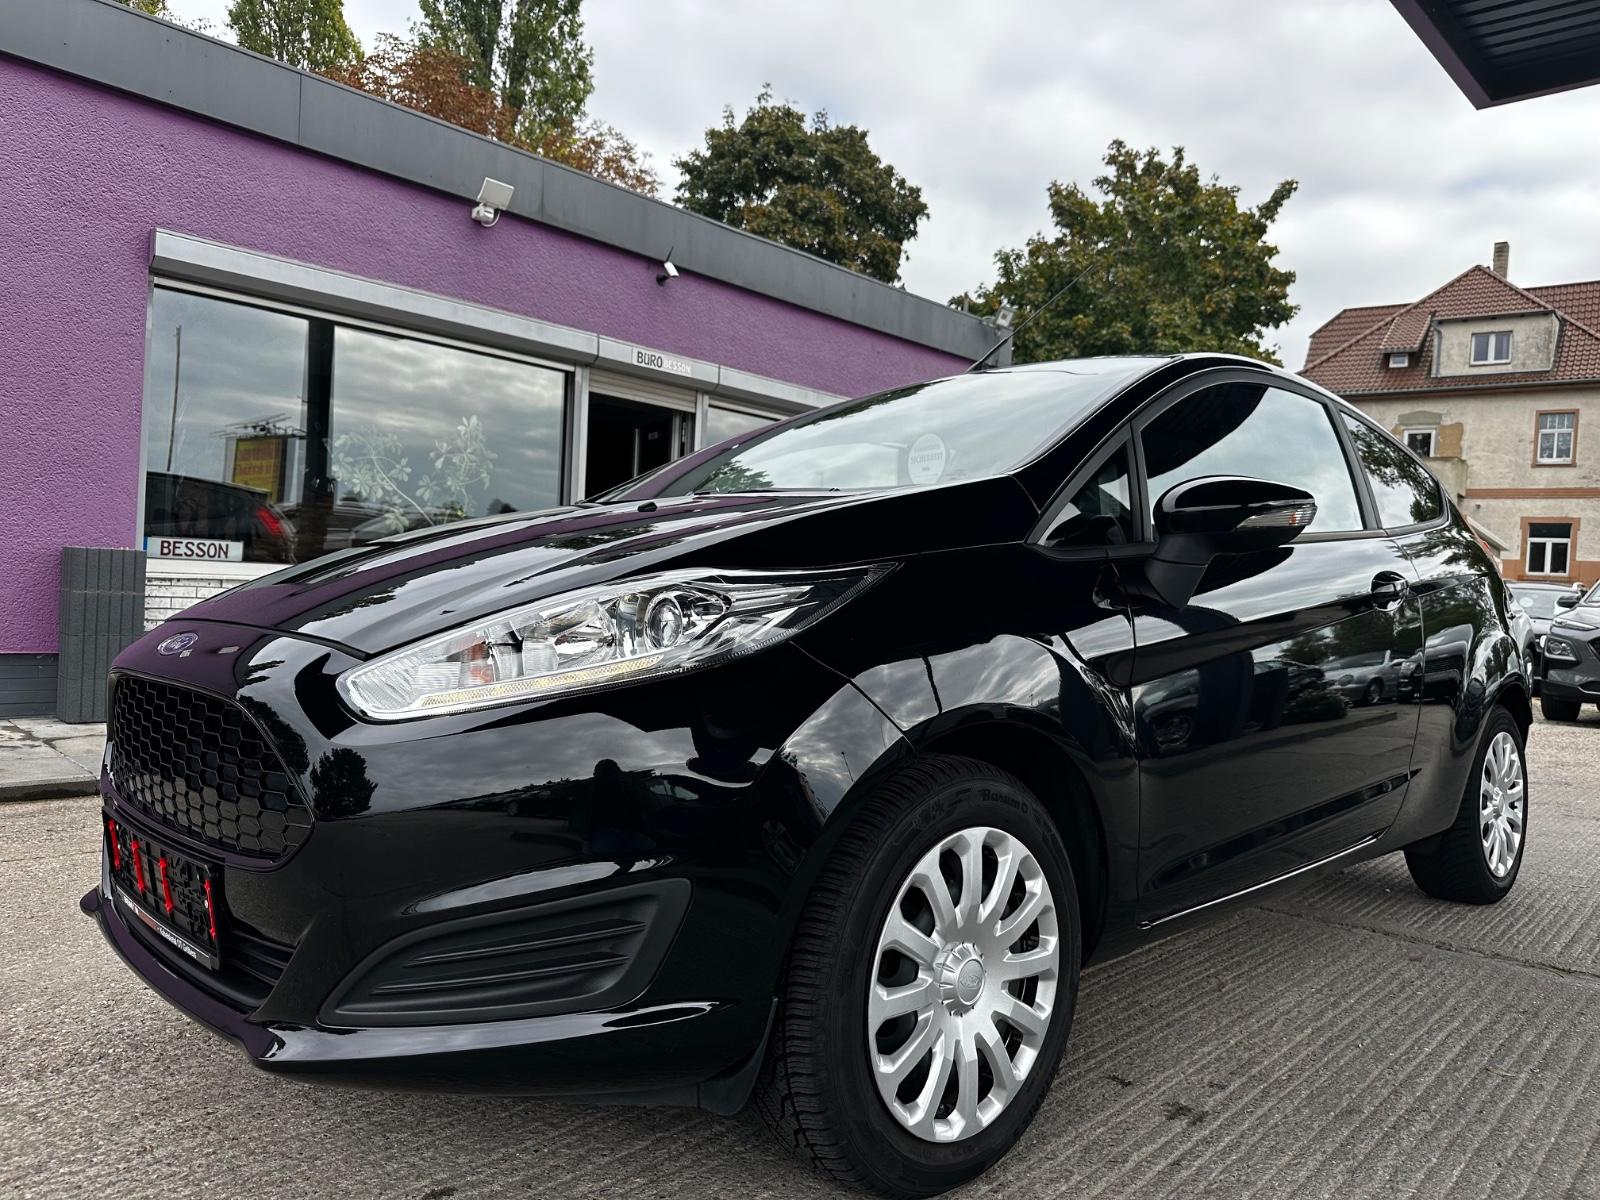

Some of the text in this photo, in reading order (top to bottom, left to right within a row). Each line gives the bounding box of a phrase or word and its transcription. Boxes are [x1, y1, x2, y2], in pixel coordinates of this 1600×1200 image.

[636, 351, 691, 374] BÜRO BESSON
[160, 540, 229, 559] BESSON
